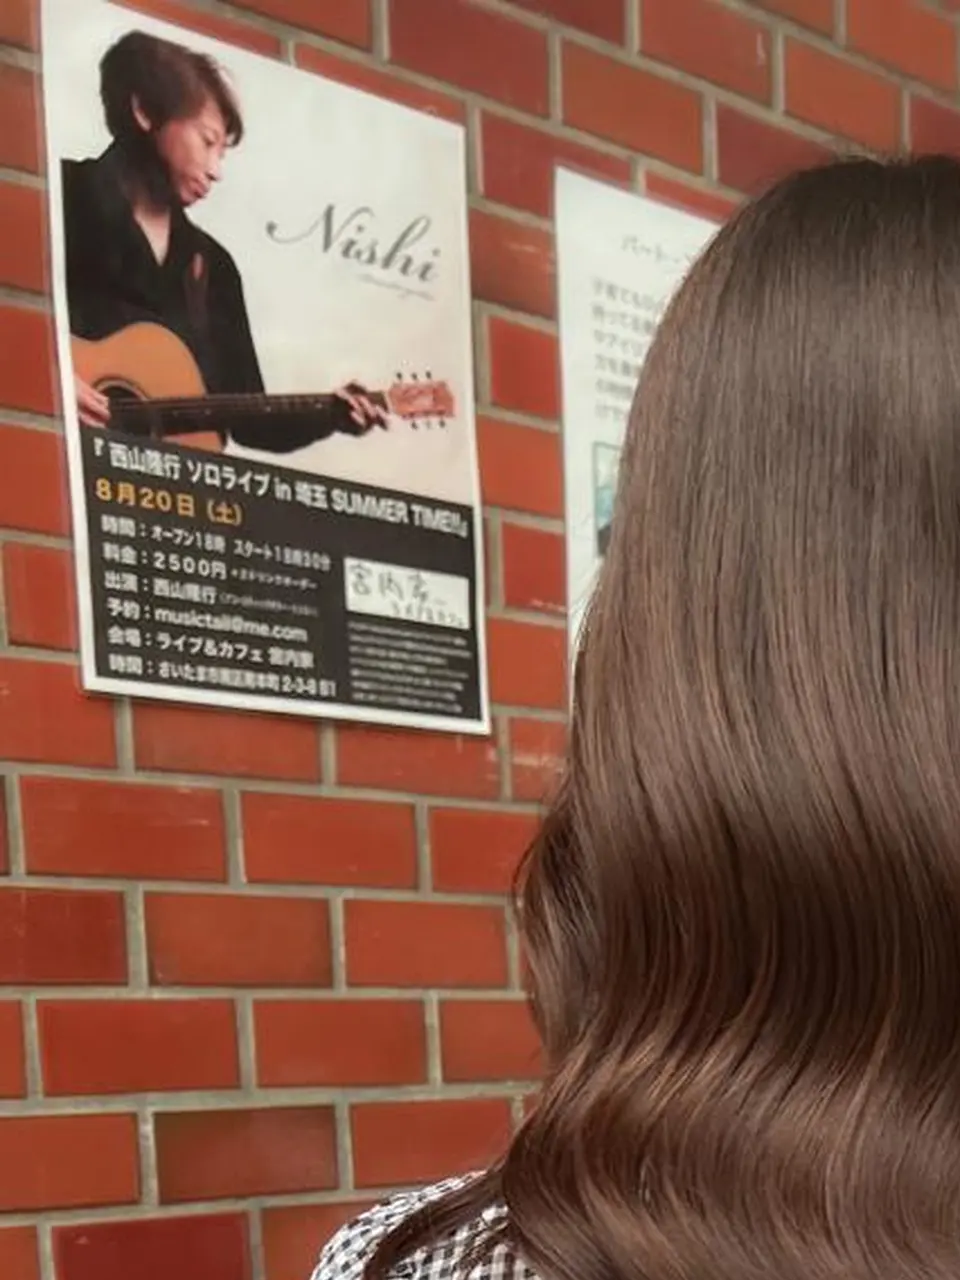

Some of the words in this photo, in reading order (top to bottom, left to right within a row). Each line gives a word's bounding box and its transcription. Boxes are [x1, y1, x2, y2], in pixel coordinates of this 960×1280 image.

[266, 203, 440, 283] Nishi
[95, 477, 196, 518] 8月20日
[186, 459, 271, 496] ソロライブ
[274, 476, 292, 502] in
[295, 480, 328, 509] 埼玉
[331, 487, 409, 524] SUMMER
